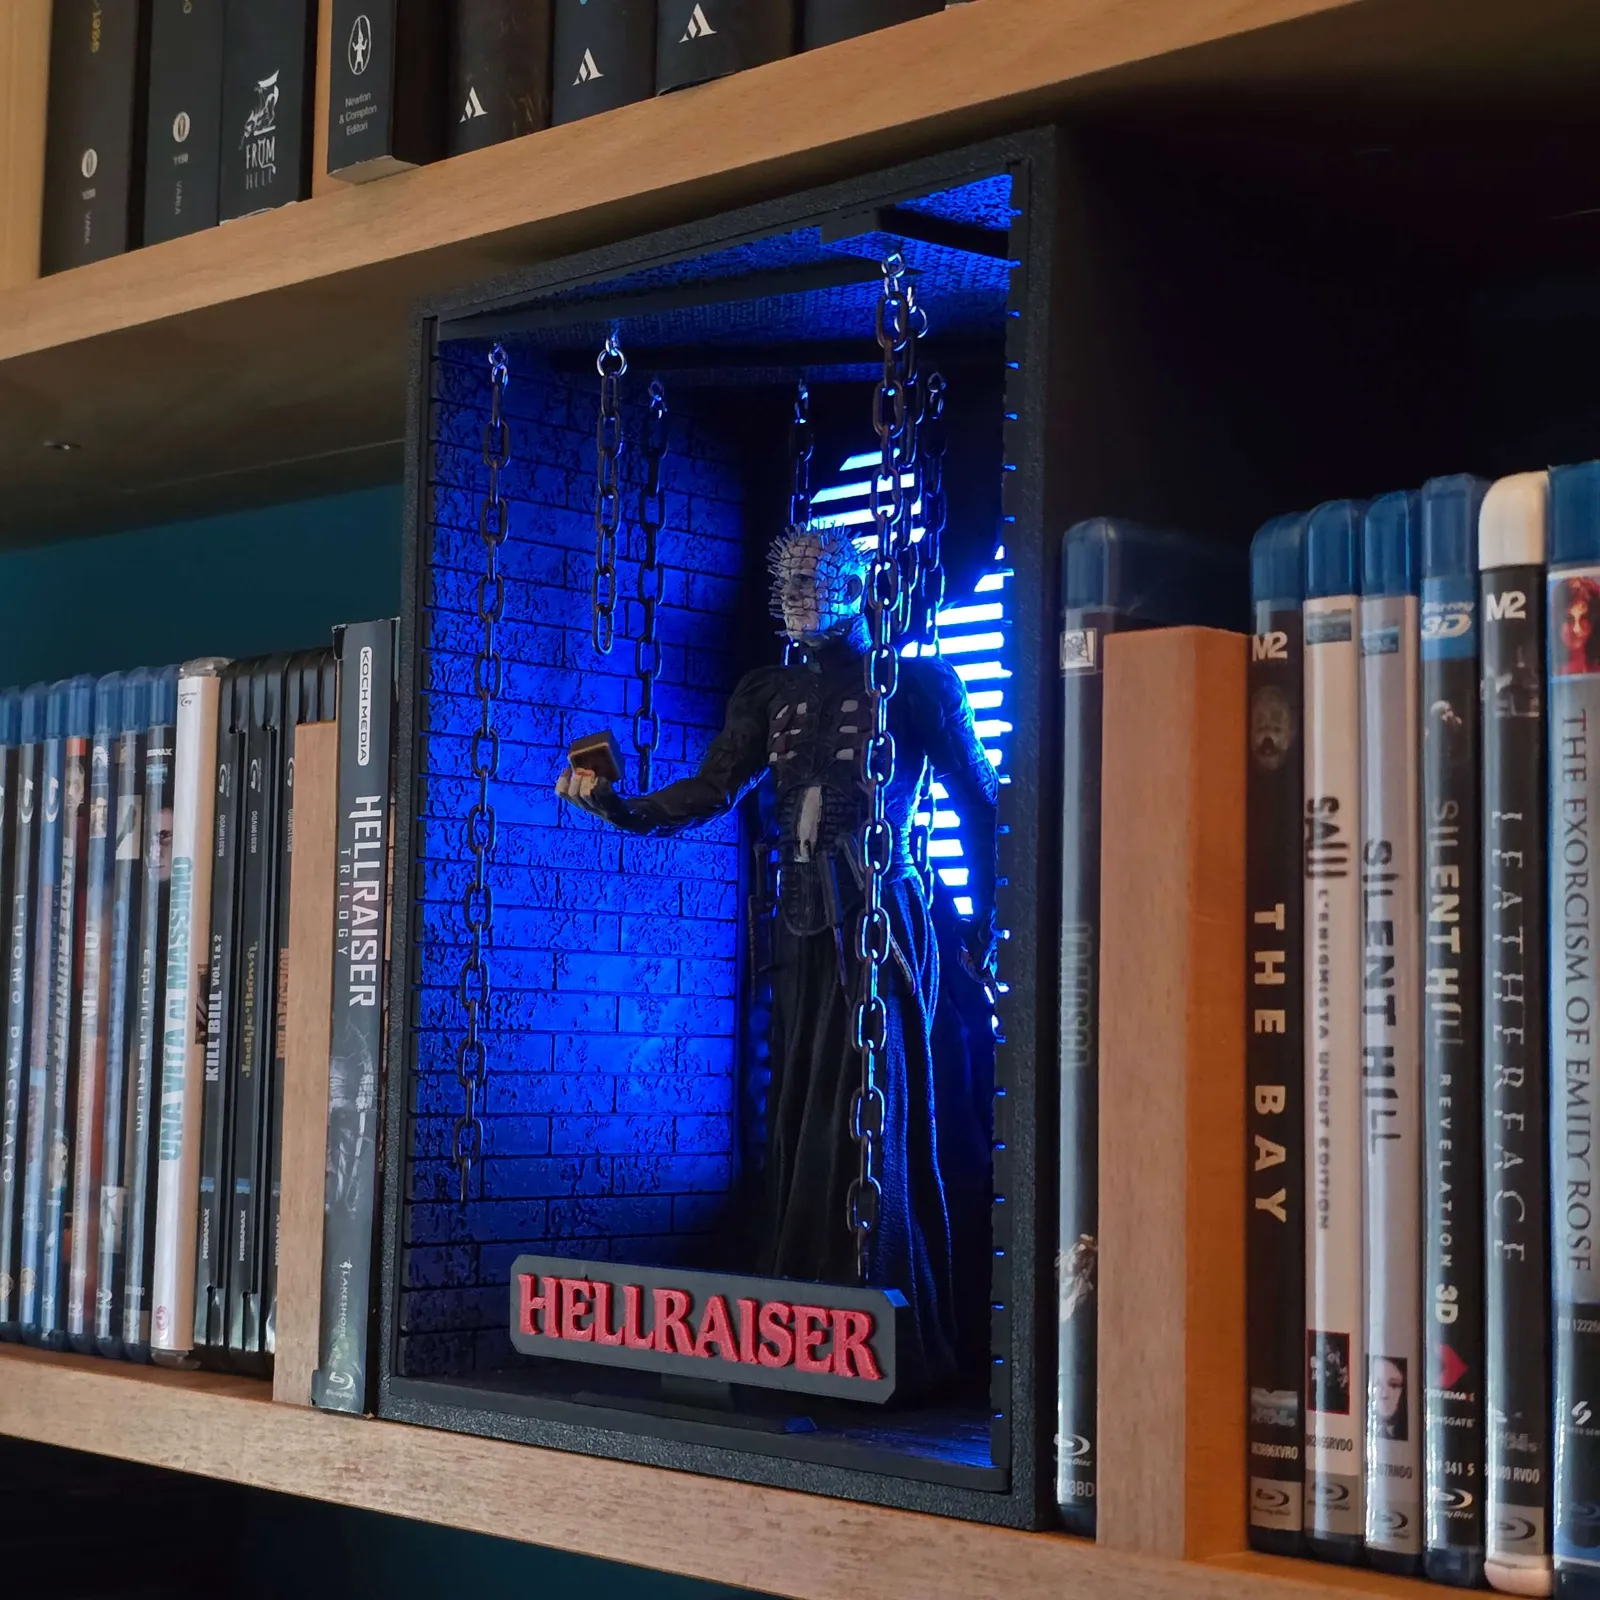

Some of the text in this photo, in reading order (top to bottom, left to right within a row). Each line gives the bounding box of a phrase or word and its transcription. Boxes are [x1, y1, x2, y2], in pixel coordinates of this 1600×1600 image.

[345, 92, 371, 108] Newton
[1252, 631, 1288, 662] M2
[1421, 613, 1472, 639] 3D
[1485, 591, 1526, 622] M2
[360, 650, 369, 761] KOCH MEDIA
[338, 848, 351, 955] TRILOGY
[348, 796, 382, 1007] HELLRAISER
[159, 856, 193, 1161] UNA VITA AL MASSIMO
[207, 990, 222, 1034] BILL
[212, 962, 221, 987] VOL.
[1363, 840, 1402, 1155] SILENT HILL
[1562, 709, 1592, 1273] THE EXORCISM OF EMILY ROSE
[2, 894, 26, 1184] L'UOMO D'ACCIAIO
[136, 948, 151, 1133] EQUILIBRIUM
[205, 1037, 221, 1081] KILL
[1254, 903, 1287, 1223] THE BAY
[1318, 1052, 1330, 1129] UNCUT
[1425, 800, 1464, 1325] SILENT HILL REVELATION 3D
[1491, 811, 1526, 1262] LEATHERFACE
[1317, 1137, 1330, 1229] EDITION
[517, 1273, 885, 1381] HELLRAISER
